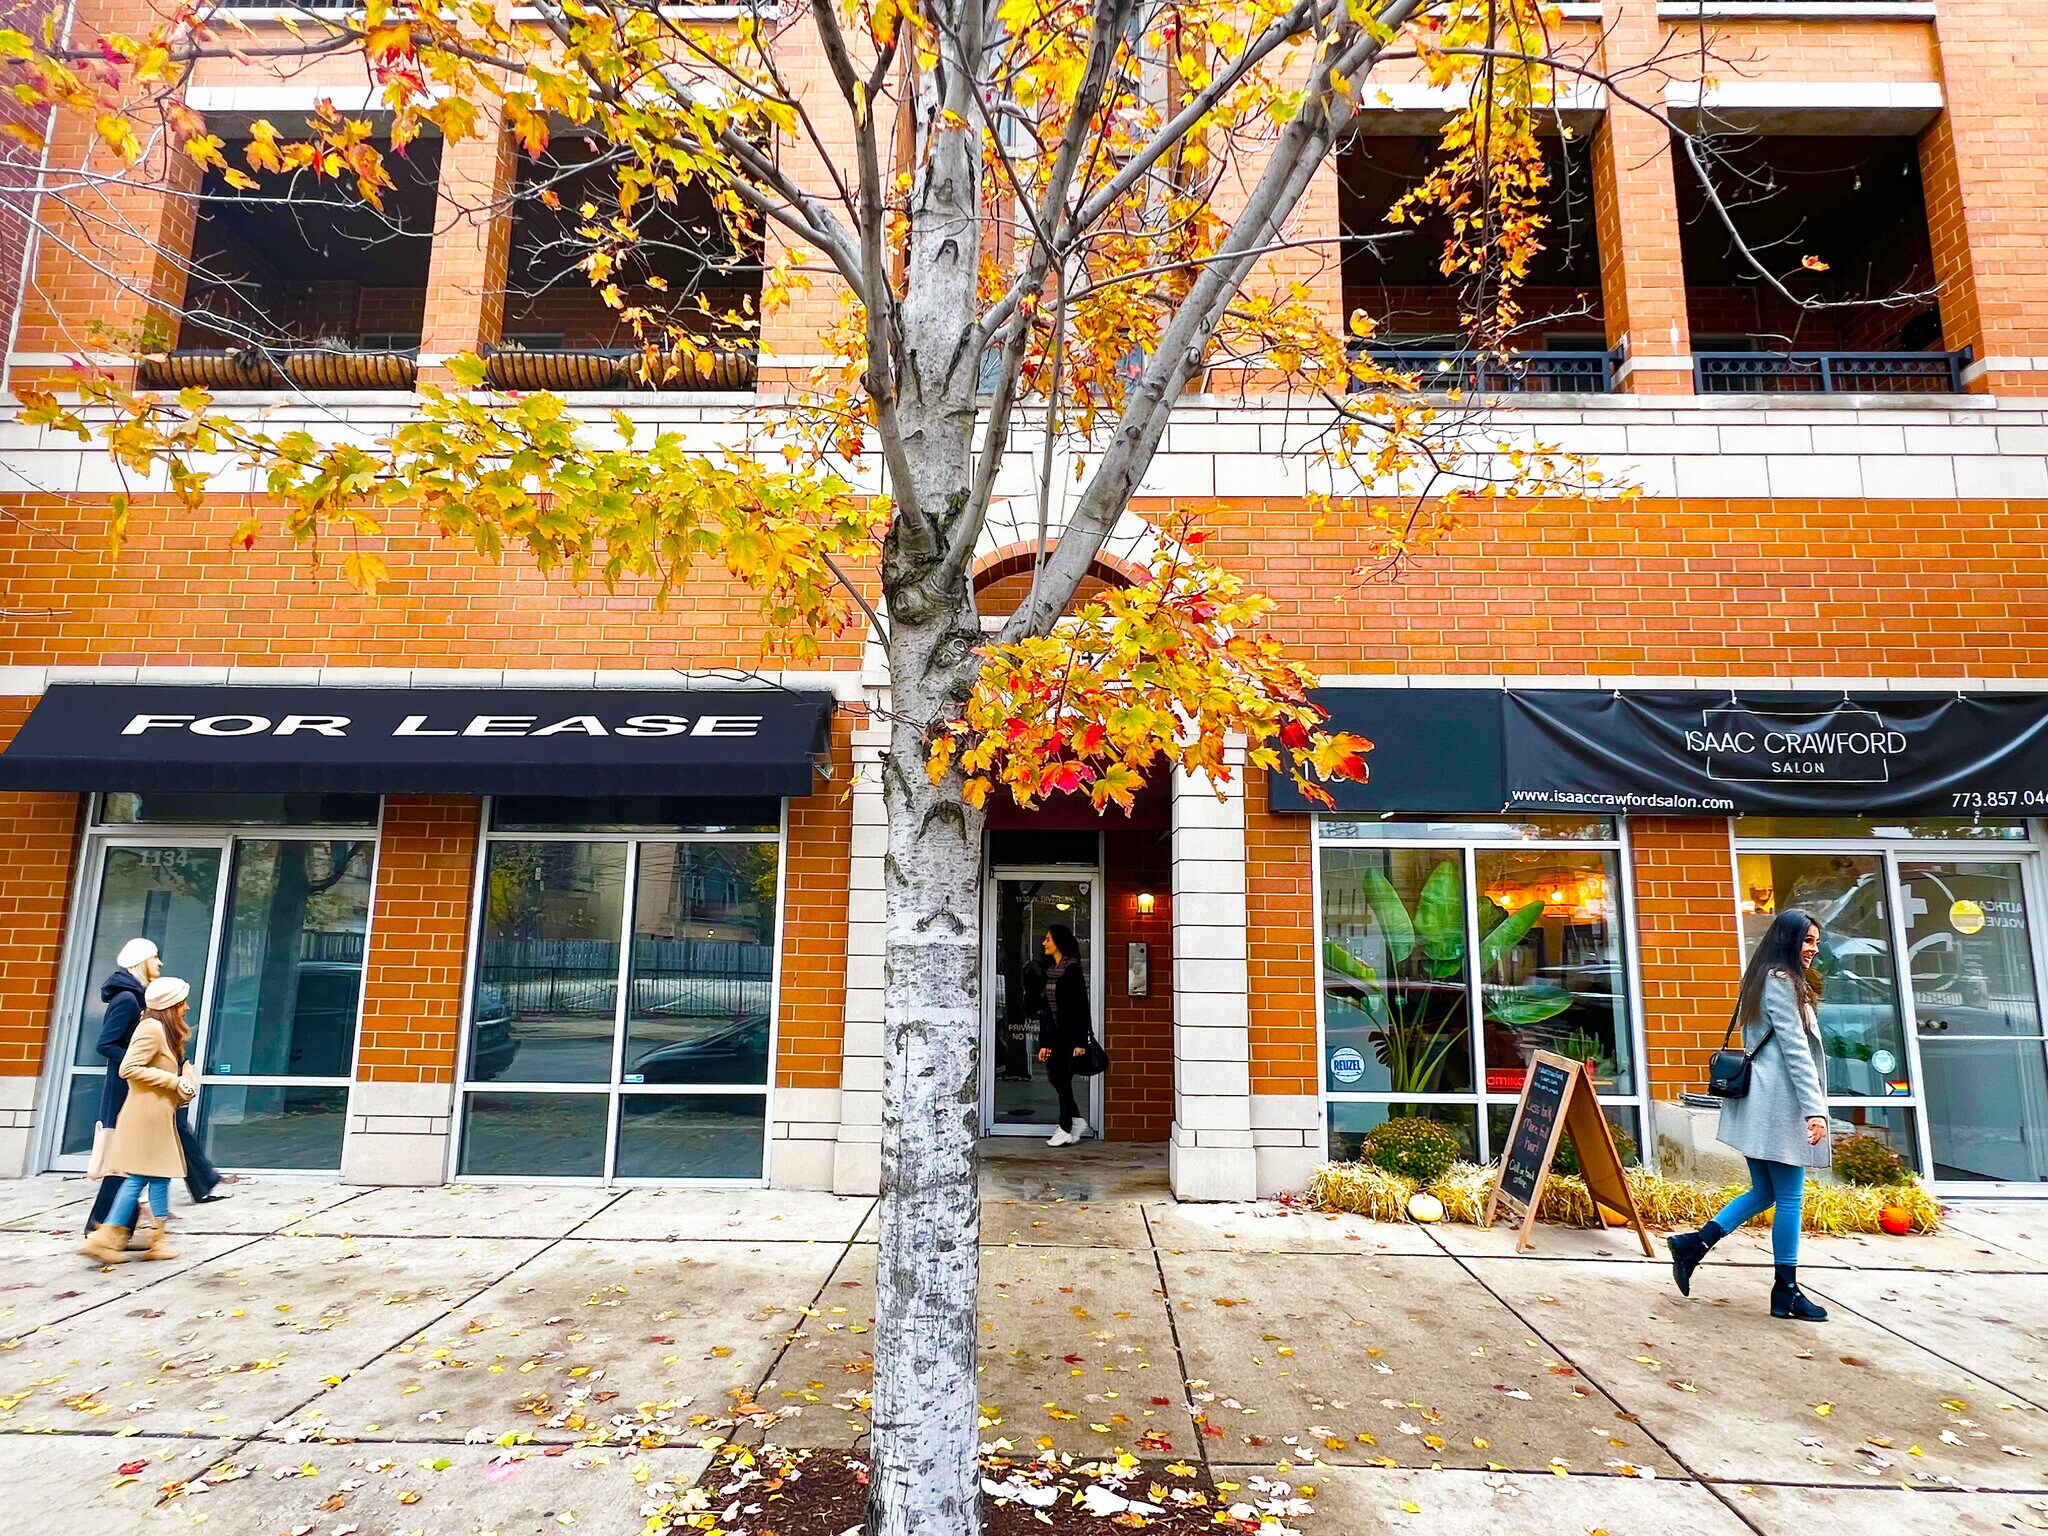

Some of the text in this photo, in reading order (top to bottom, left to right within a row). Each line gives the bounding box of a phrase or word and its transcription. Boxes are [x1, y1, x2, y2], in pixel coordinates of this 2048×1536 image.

[120, 713, 764, 737] FOR LEASE
[1685, 730, 1907, 754] ISAAC CRAWFORD
[1771, 760, 1825, 774] SALON
[1511, 789, 1735, 810] www.isaaccrawfordsalon.com
[1952, 790, 2048, 808] 773.857.04
[1333, 1059, 1362, 1071] REUZEL
